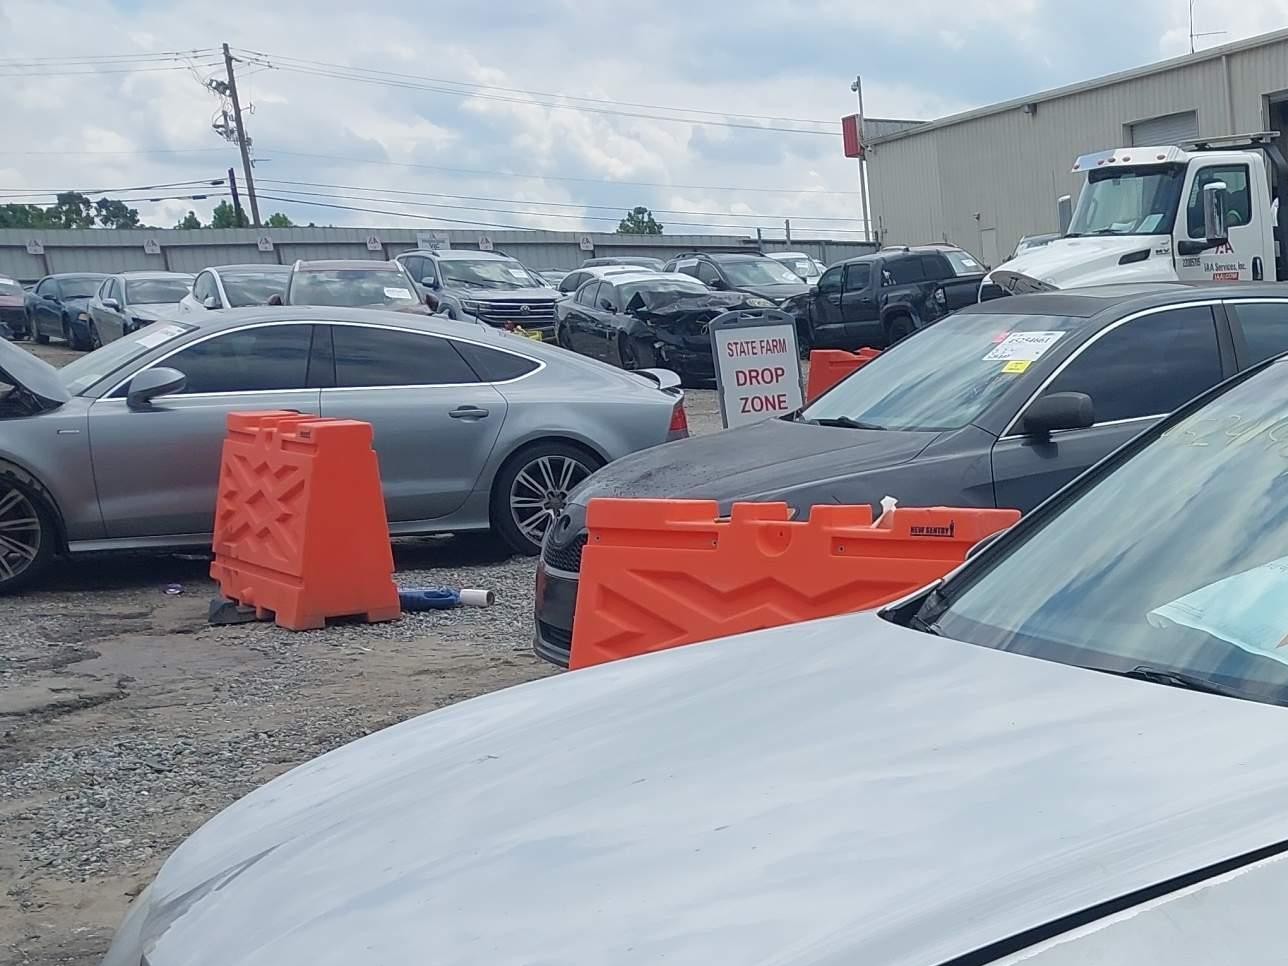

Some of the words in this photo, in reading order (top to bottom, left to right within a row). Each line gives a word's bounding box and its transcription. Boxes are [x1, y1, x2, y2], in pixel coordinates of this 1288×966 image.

[727, 341, 757, 357] STATE
[760, 338, 787, 355] FARM
[736, 367, 785, 386] DROP
[740, 394, 788, 413] ZONE
